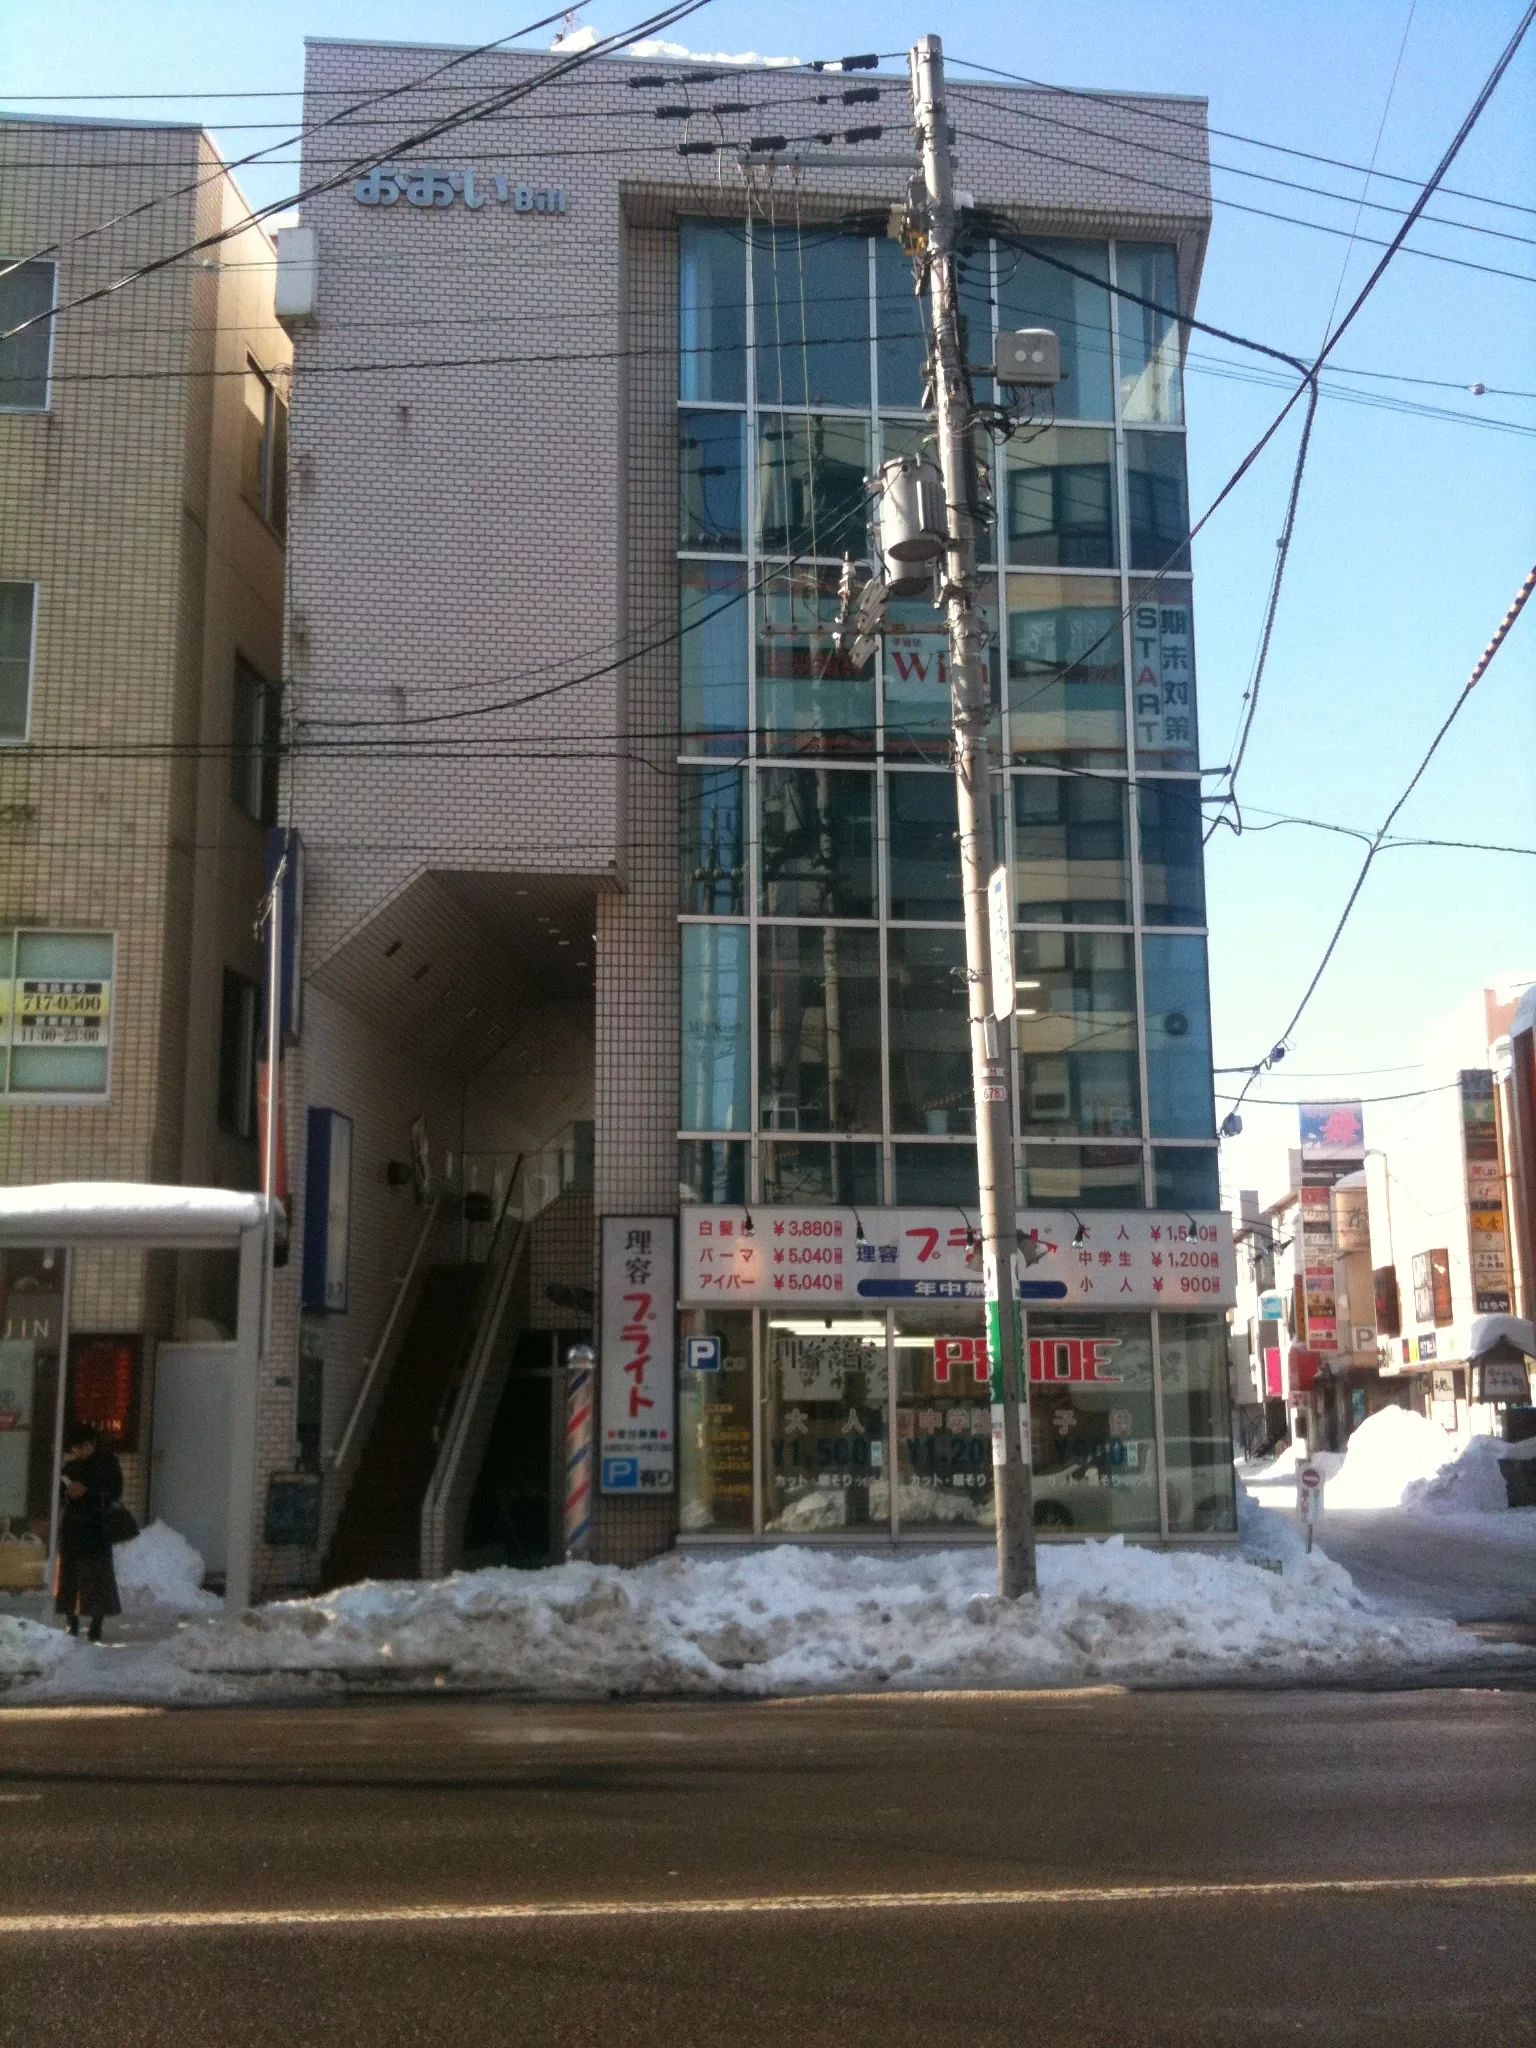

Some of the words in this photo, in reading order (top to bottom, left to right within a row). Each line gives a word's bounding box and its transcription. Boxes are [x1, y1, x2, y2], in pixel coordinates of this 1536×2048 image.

[1135, 607, 1161, 743] START
[1160, 609, 1189, 741] 期末対策
[1150, 1225, 1210, 1242] ¥1,50
[625, 1229, 653, 1285] 理容
[856, 1244, 899, 1264] 理容
[1078, 1250, 1133, 1268] 中学生
[1080, 1276, 1134, 1292] 小人
[1356, 1328, 1373, 1350] P
[690, 1340, 716, 1368] P
[933, 1337, 1123, 1383] PIDE
[785, 1408, 865, 1434] 大人
